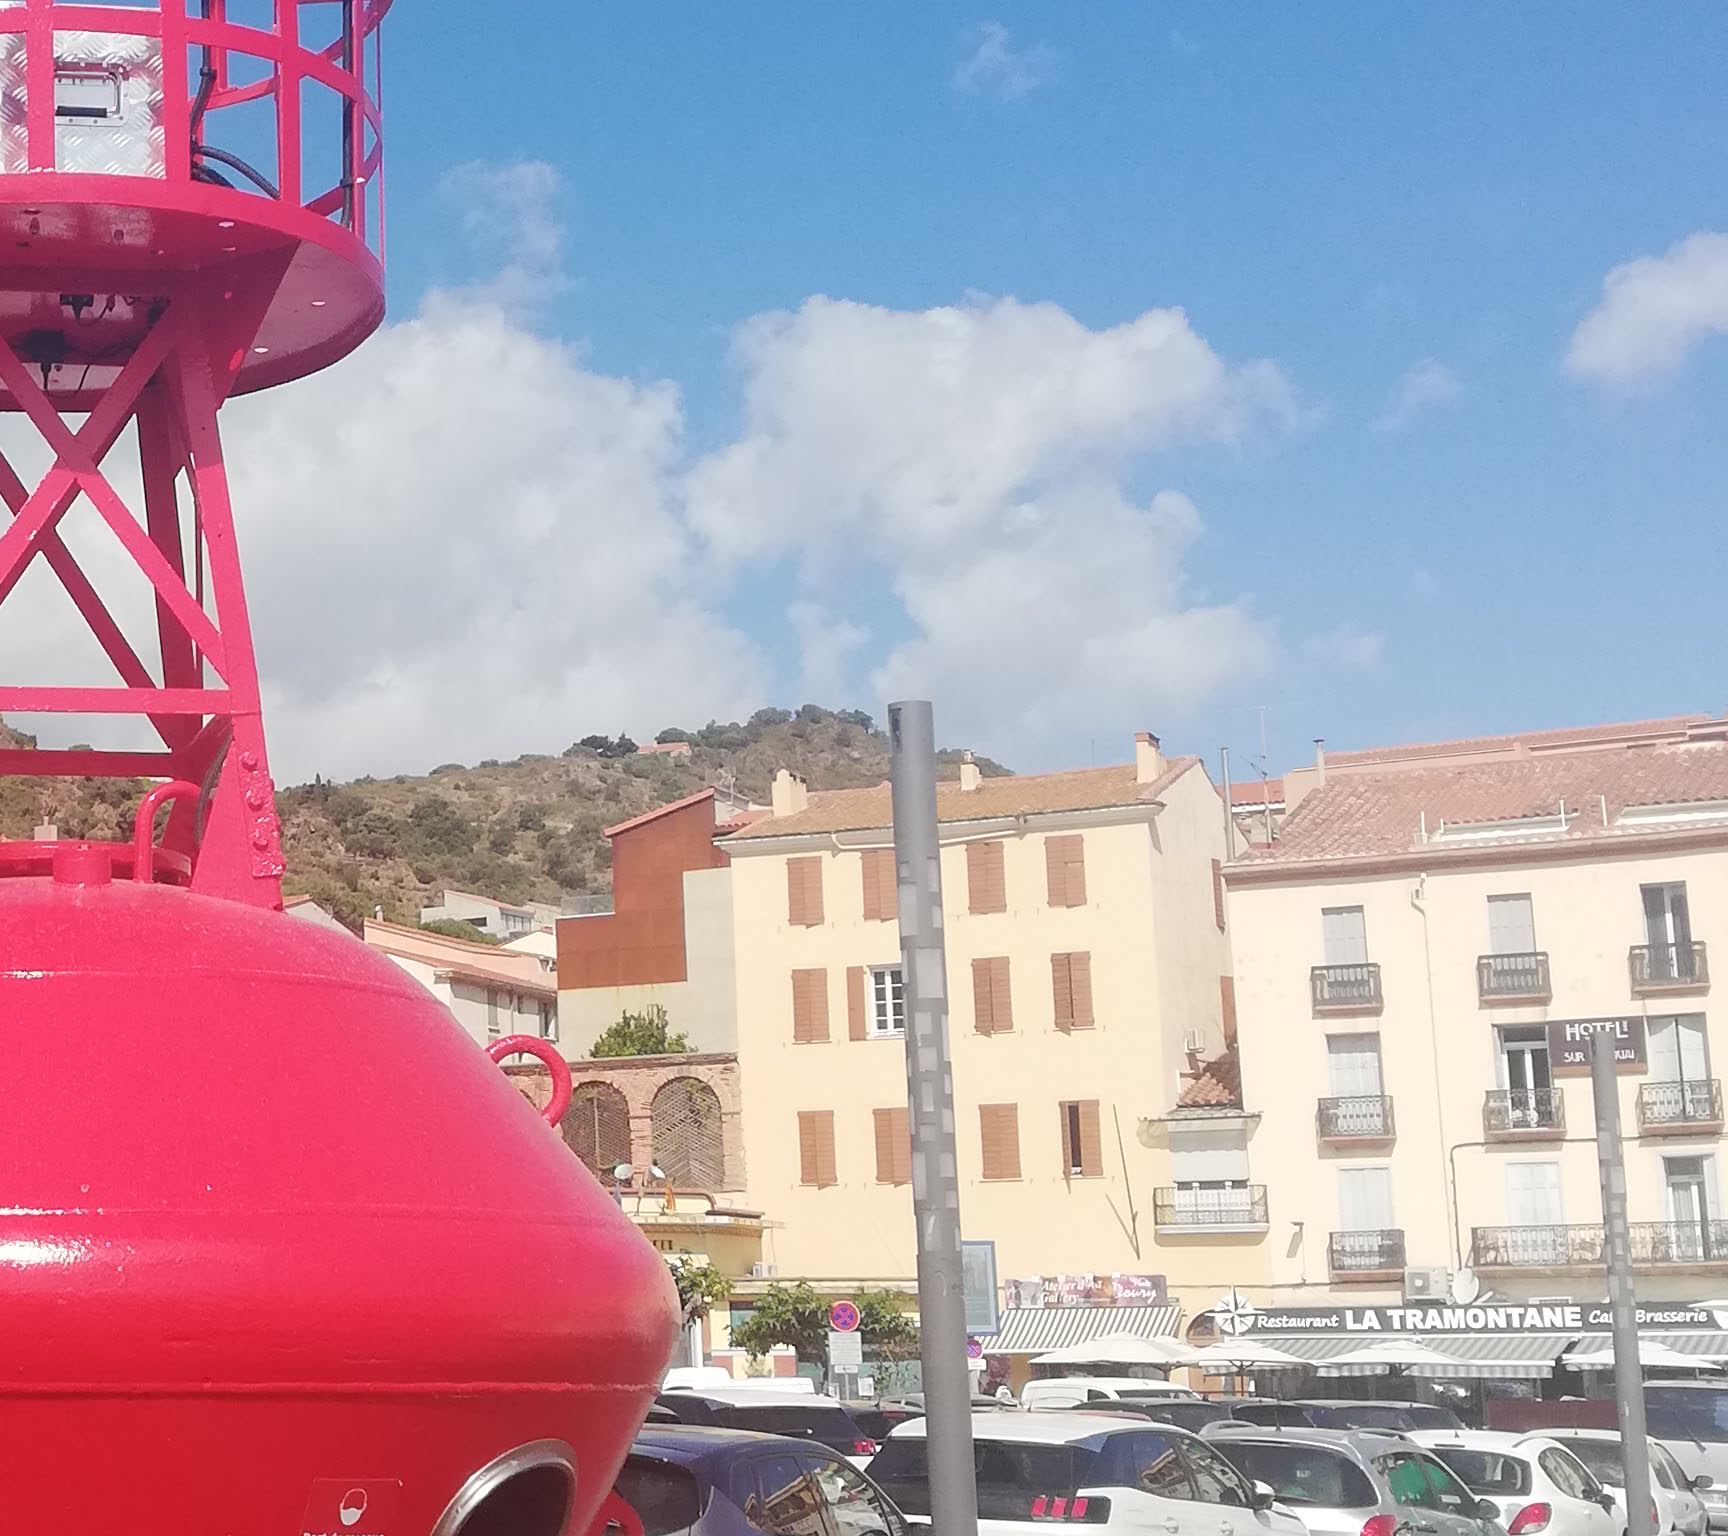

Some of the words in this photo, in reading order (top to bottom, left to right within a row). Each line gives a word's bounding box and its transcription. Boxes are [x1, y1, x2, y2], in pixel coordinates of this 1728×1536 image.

[1257, 1314, 1339, 1329] Restaurant
[1345, 1309, 1382, 1331] LA
[1387, 1306, 1582, 1331] TRAMONTANE
[1588, 1309, 1613, 1324] Ca
[1636, 1307, 1708, 1324] Brasserie
